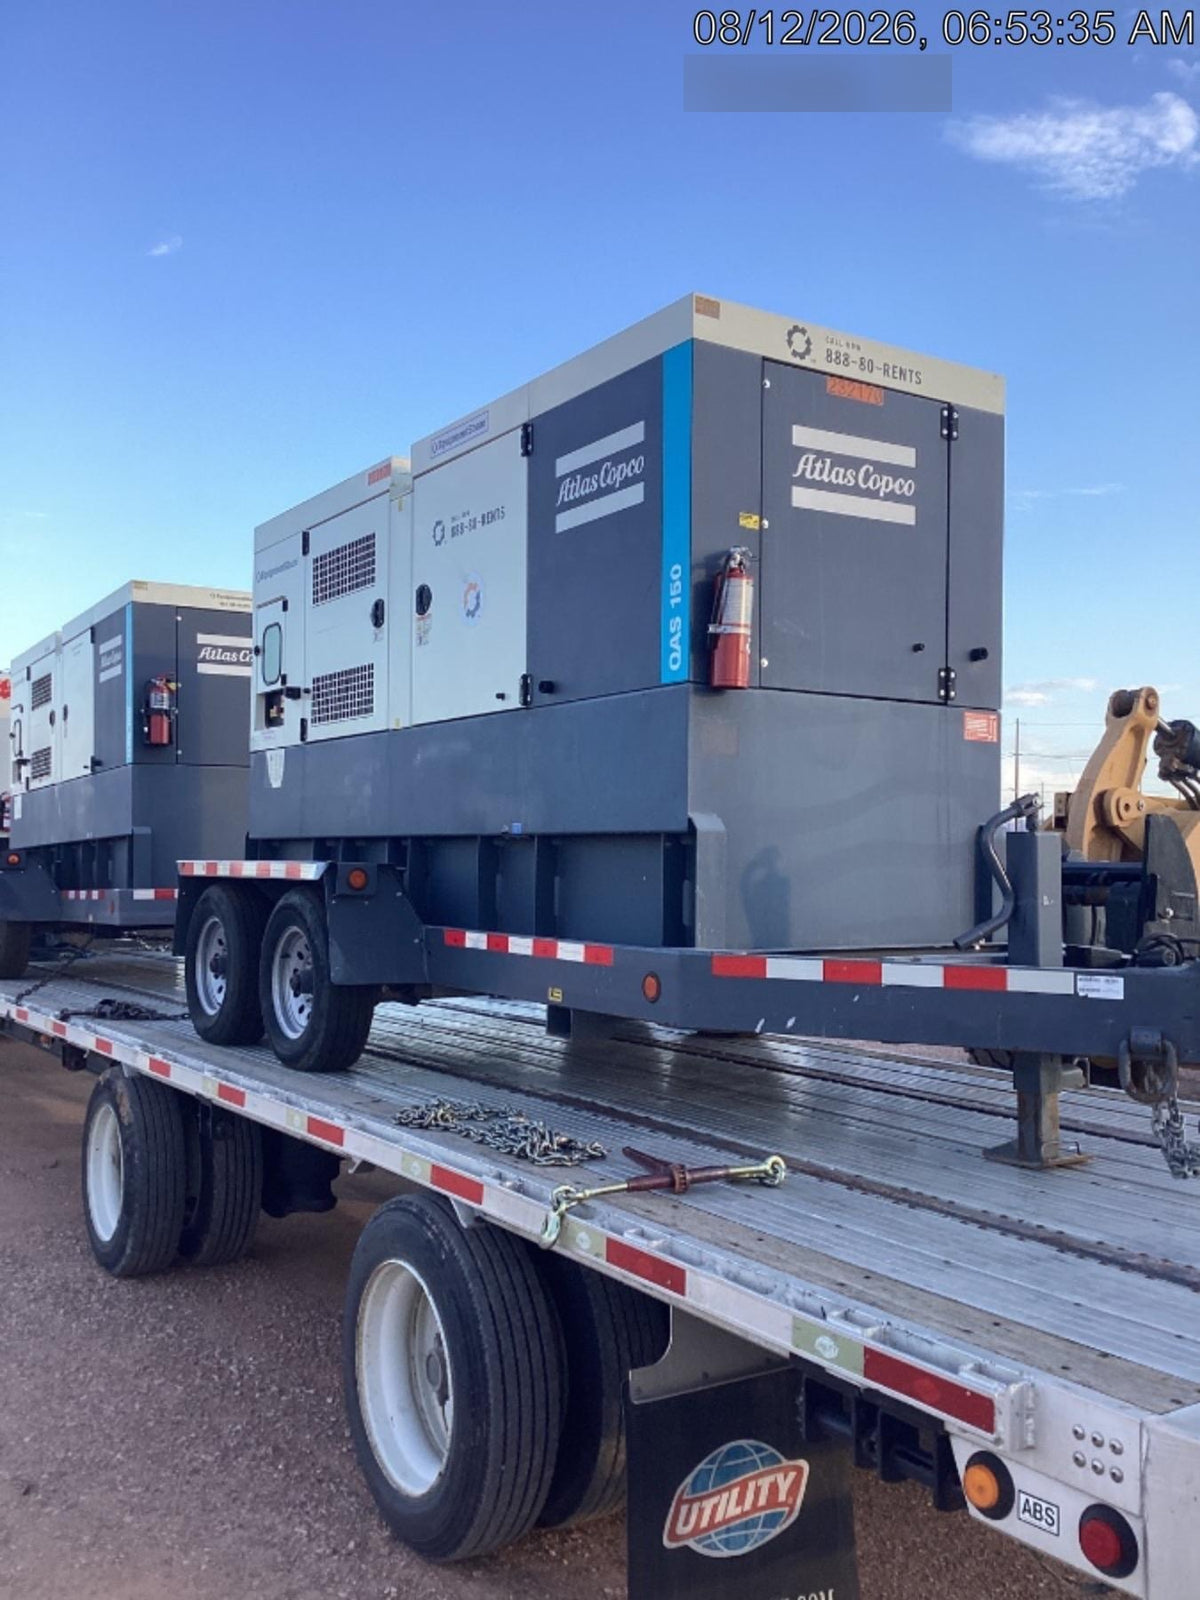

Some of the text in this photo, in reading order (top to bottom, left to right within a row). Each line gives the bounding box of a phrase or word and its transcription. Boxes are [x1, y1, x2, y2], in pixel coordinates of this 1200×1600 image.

[825, 348, 922, 385] 888-80-RENTS
[556, 454, 645, 508] Atlas Copco
[792, 453, 915, 497] Atlas Copco
[669, 563, 682, 609] 150
[198, 647, 238, 662] Atlas
[675, 1471, 798, 1535] UTILITY
[1021, 1497, 1056, 1528] ABS
